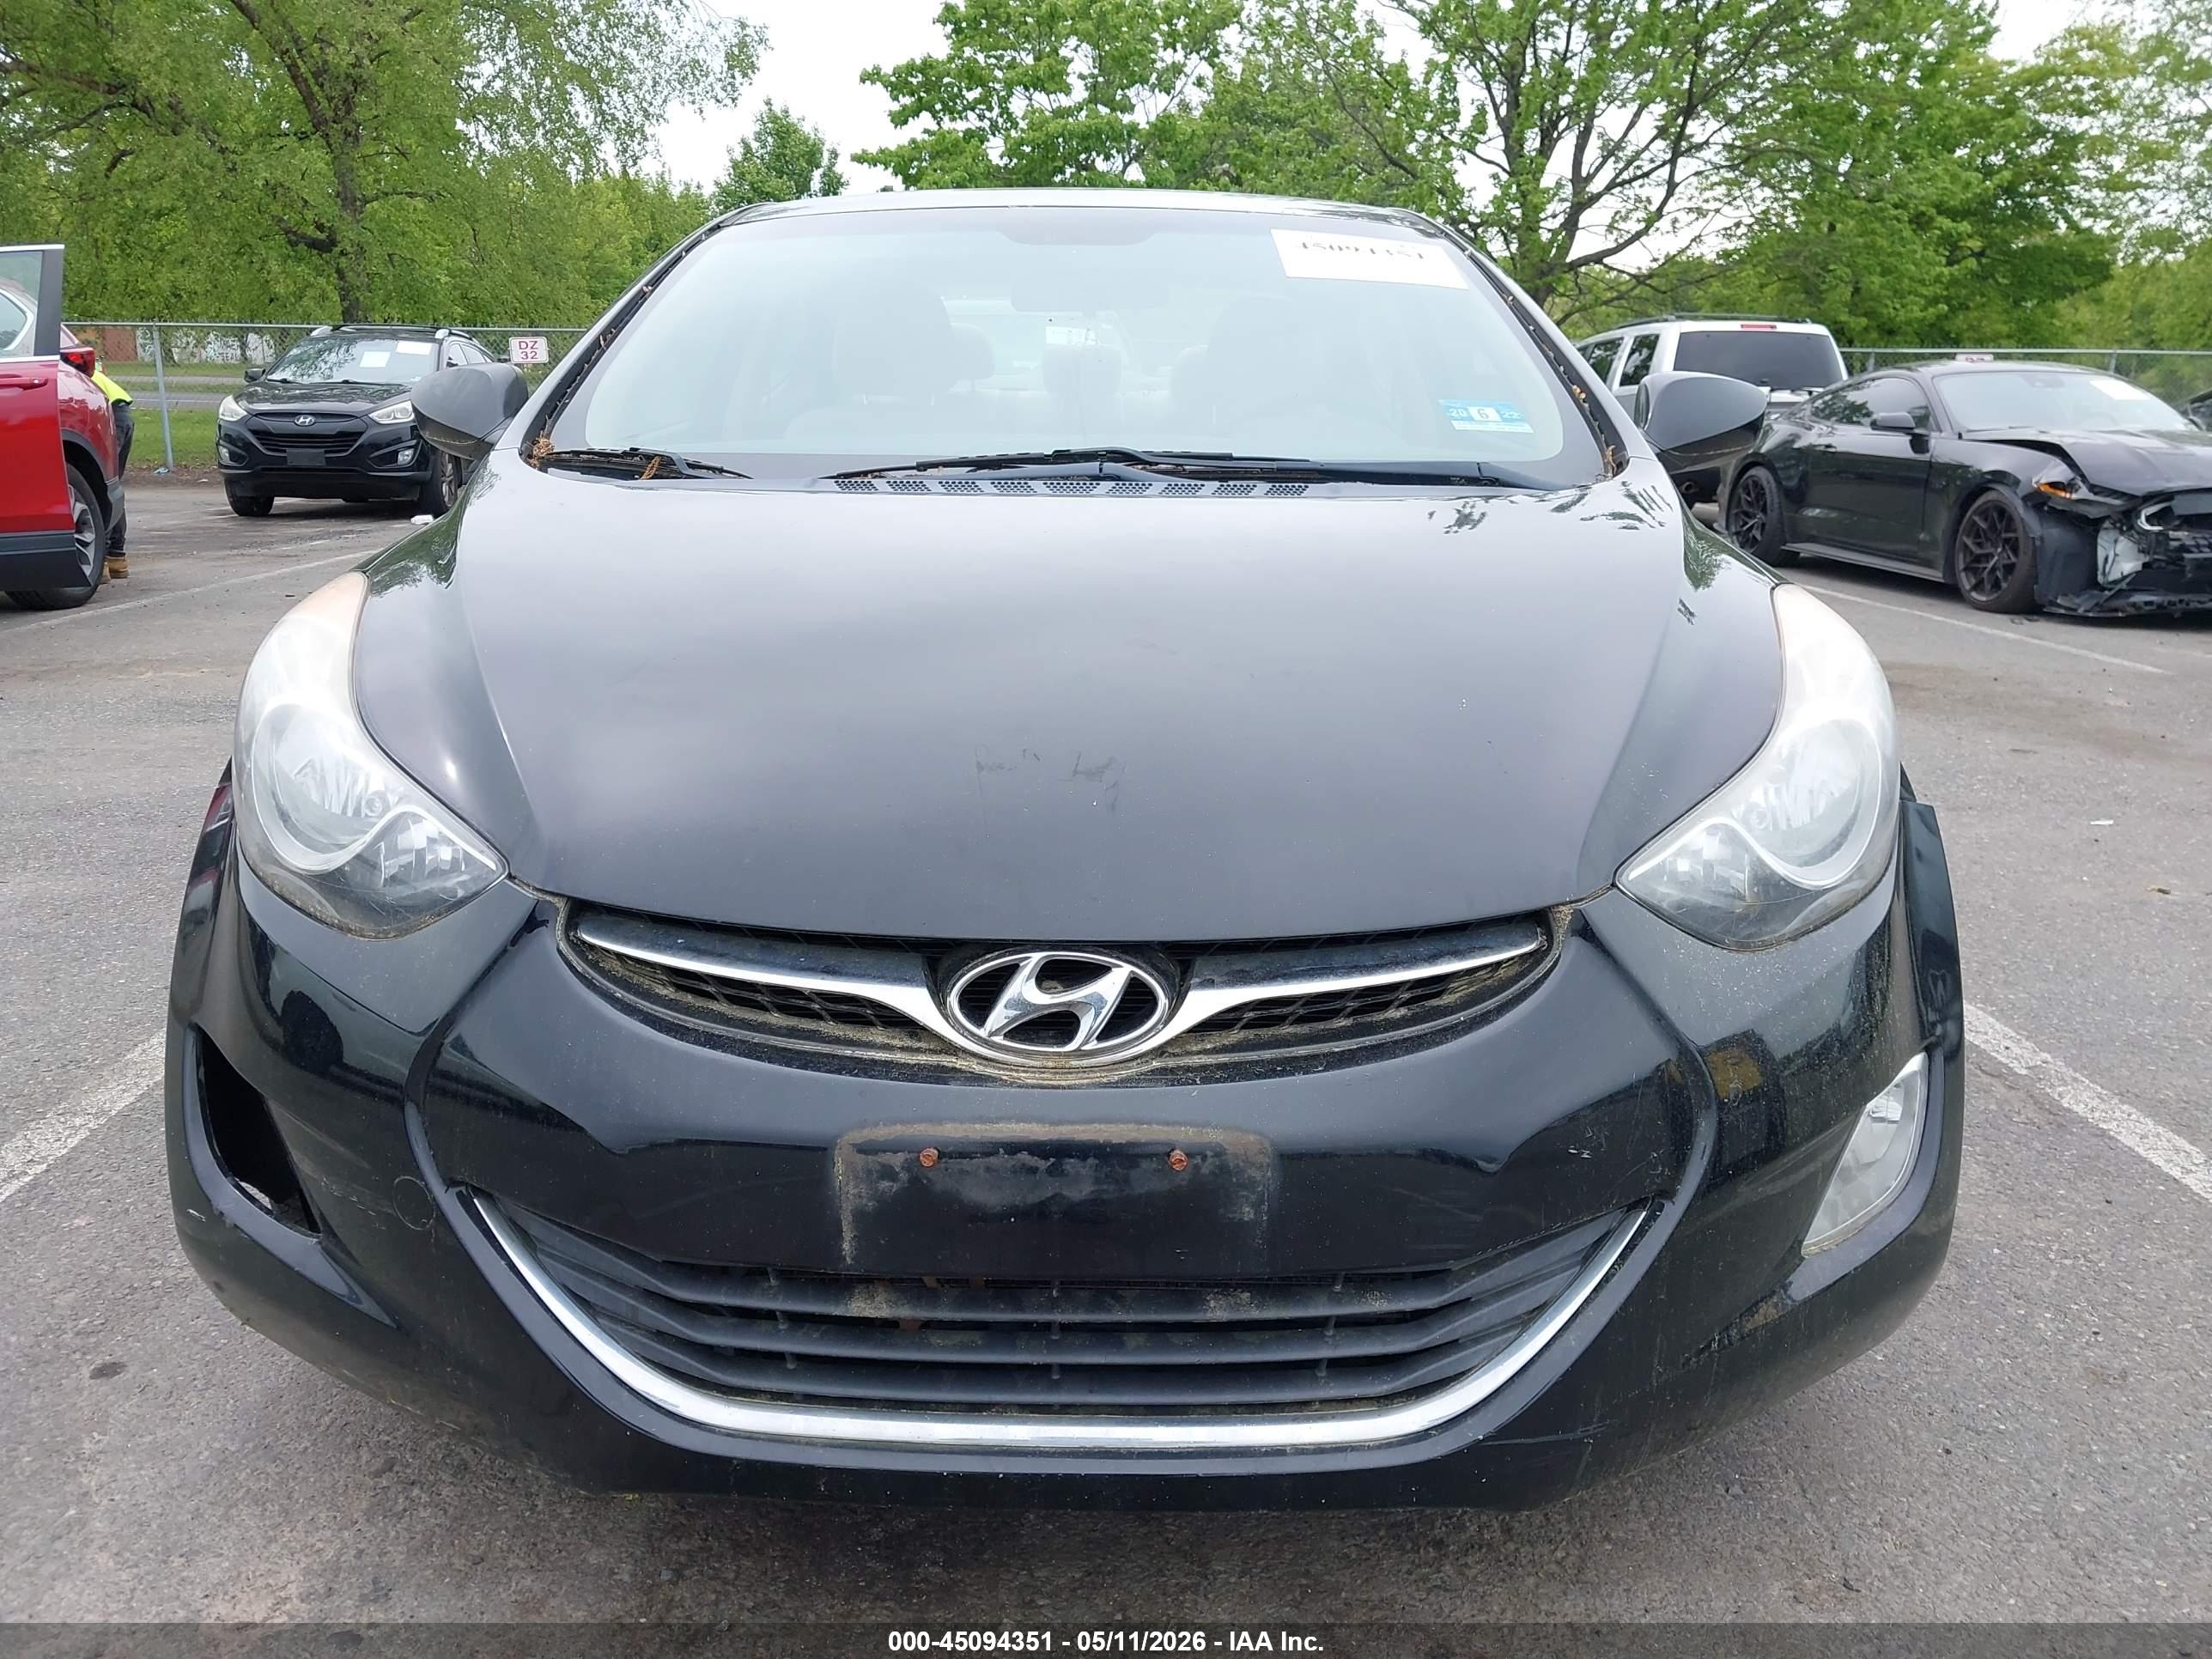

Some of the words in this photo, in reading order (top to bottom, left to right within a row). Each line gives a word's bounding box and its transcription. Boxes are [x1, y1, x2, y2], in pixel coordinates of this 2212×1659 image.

[518, 340, 538, 350] DZ
[520, 350, 538, 361] 32
[1476, 408, 1490, 420] 6
